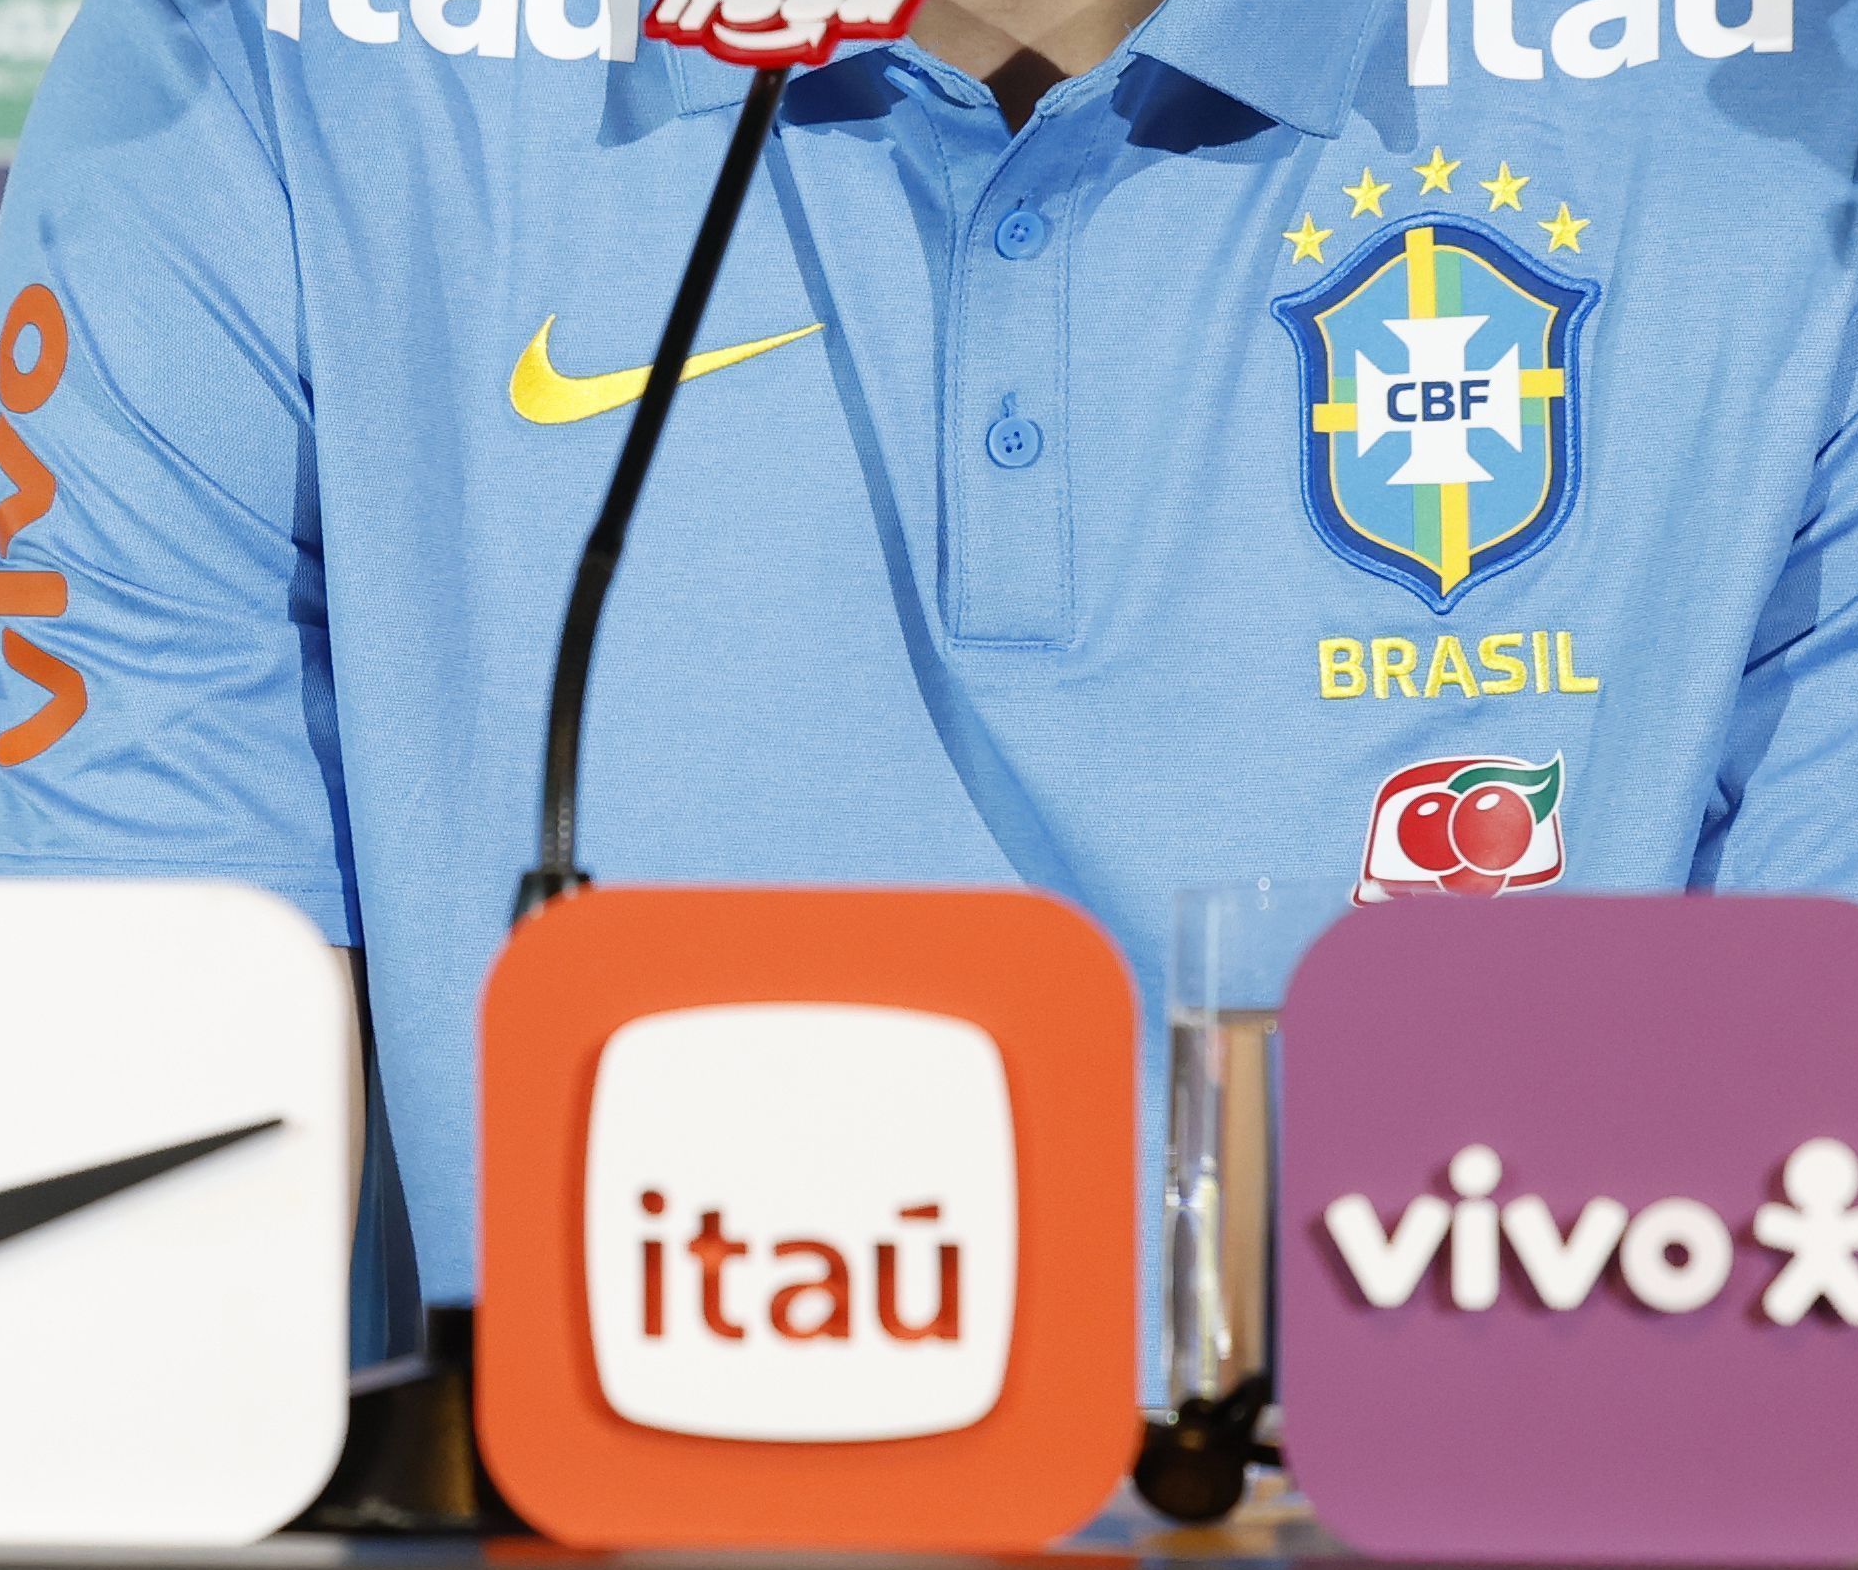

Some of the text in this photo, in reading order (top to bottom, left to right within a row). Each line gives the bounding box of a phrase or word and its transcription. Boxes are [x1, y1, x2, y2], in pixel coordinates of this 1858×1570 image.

[1386, 377, 1492, 425] CBF
[1317, 629, 1600, 701] BRASIL
[638, 1189, 964, 1344] itaú
[1322, 1144, 1736, 1316] vivo
